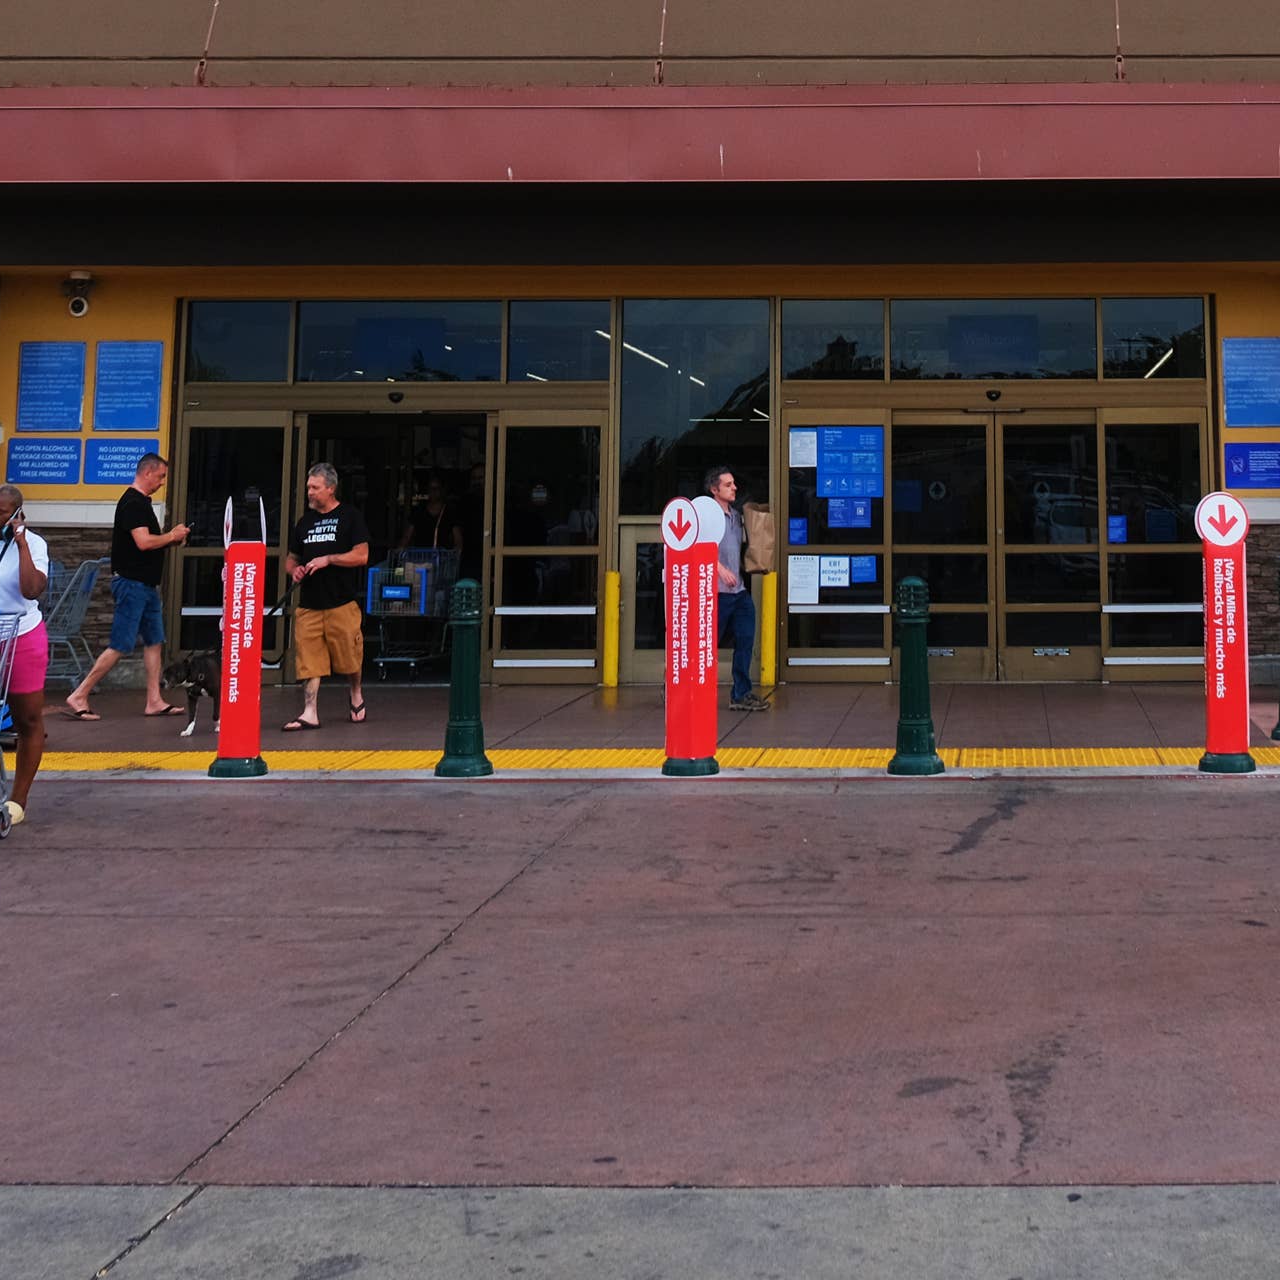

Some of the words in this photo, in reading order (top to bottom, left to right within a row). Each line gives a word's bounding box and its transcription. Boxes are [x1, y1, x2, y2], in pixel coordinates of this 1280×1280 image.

[315, 525, 336, 533] MYTH
[244, 563, 256, 597] ¡Vaya!
[672, 564, 680, 578] of
[681, 564, 689, 598] Wow!
[699, 564, 706, 578] of
[706, 563, 714, 596] Wow!
[1213, 558, 1225, 614] Rollbacks
[1223, 559, 1234, 592] ¡Vaya!
[232, 563, 244, 619] Rollbacks
[244, 600, 254, 630] Miles
[672, 579, 680, 638] Rollbacks
[1226, 595, 1236, 626] Miles
[243, 632, 253, 648] de
[672, 640, 680, 648] &
[681, 600, 689, 668] Thousands
[699, 640, 706, 649] &
[706, 598, 714, 667] Thousands
[1227, 628, 1236, 644] de
[230, 633, 240, 674] mucho
[1215, 628, 1225, 670] mucho
[228, 678, 239, 703] más
[1216, 673, 1226, 698] más
